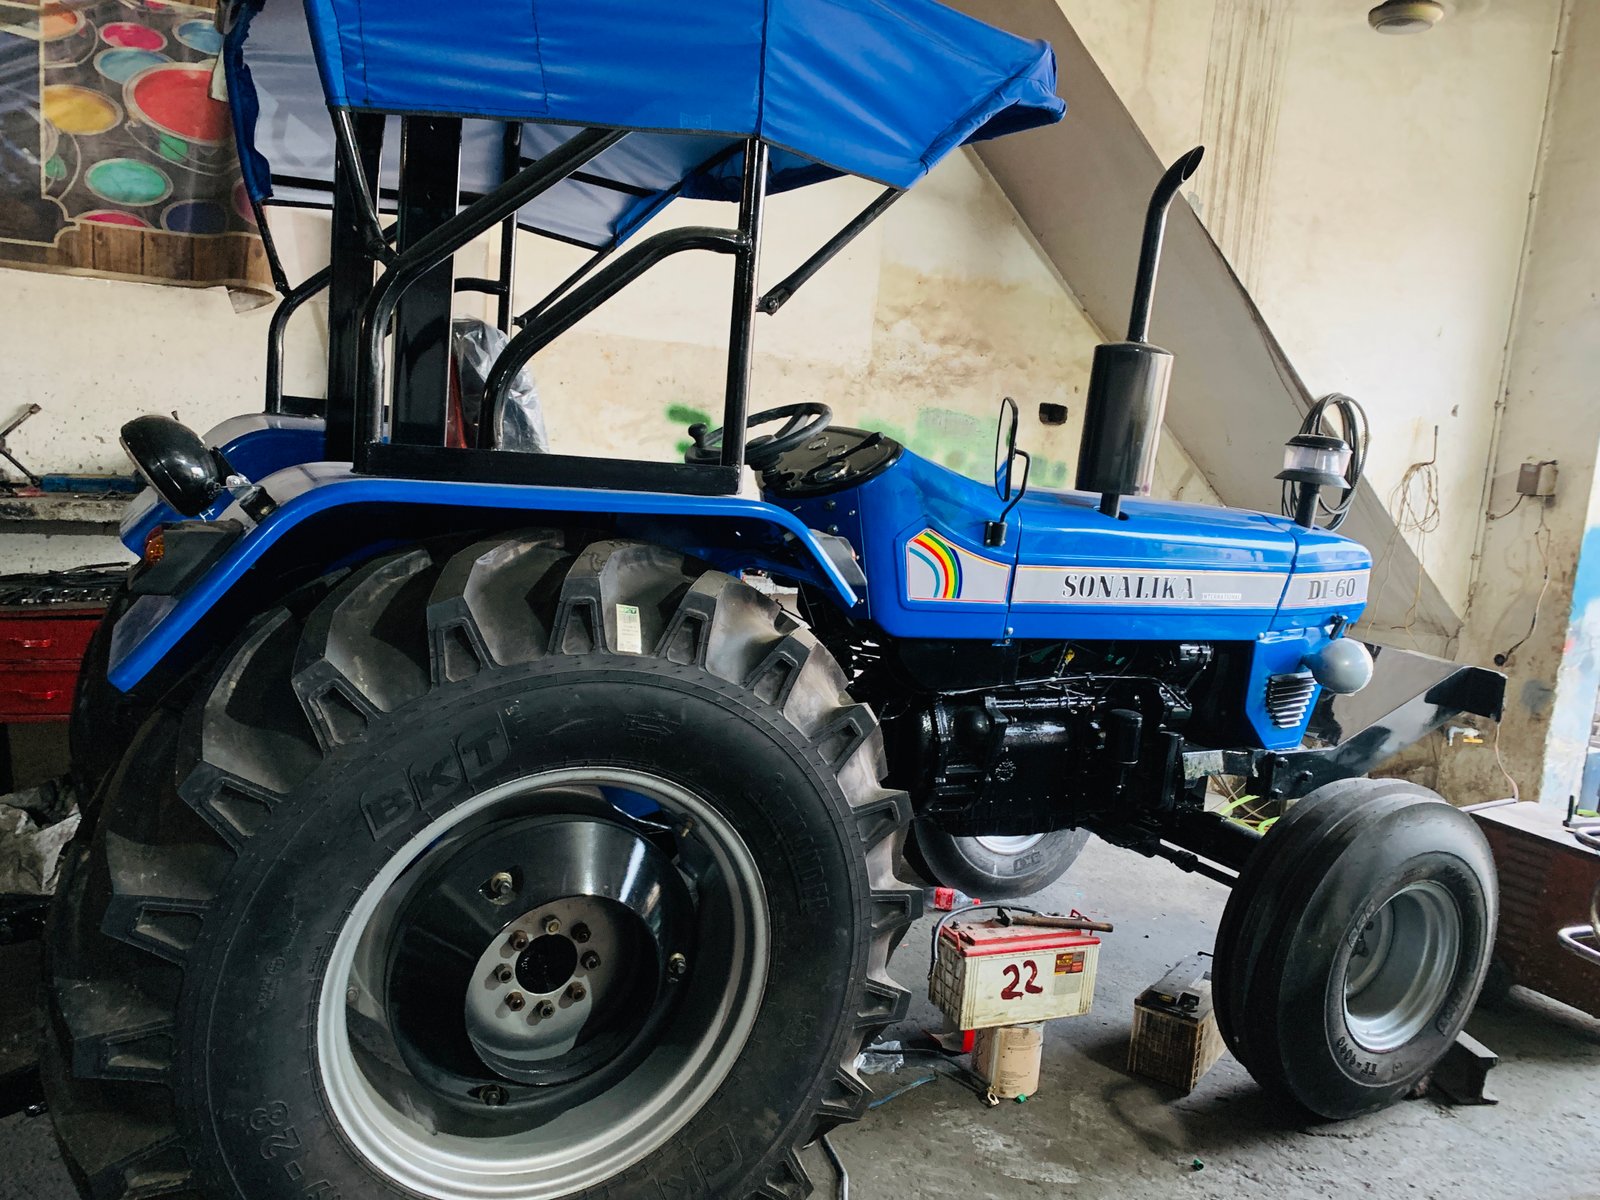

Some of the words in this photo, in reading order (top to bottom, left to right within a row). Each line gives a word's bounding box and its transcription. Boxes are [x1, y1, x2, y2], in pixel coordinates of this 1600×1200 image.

[1062, 573, 1195, 600] SONALIKA
[1307, 578, 1356, 601] DI-60
[363, 720, 507, 834] BKT
[1001, 960, 1043, 1000] 22
